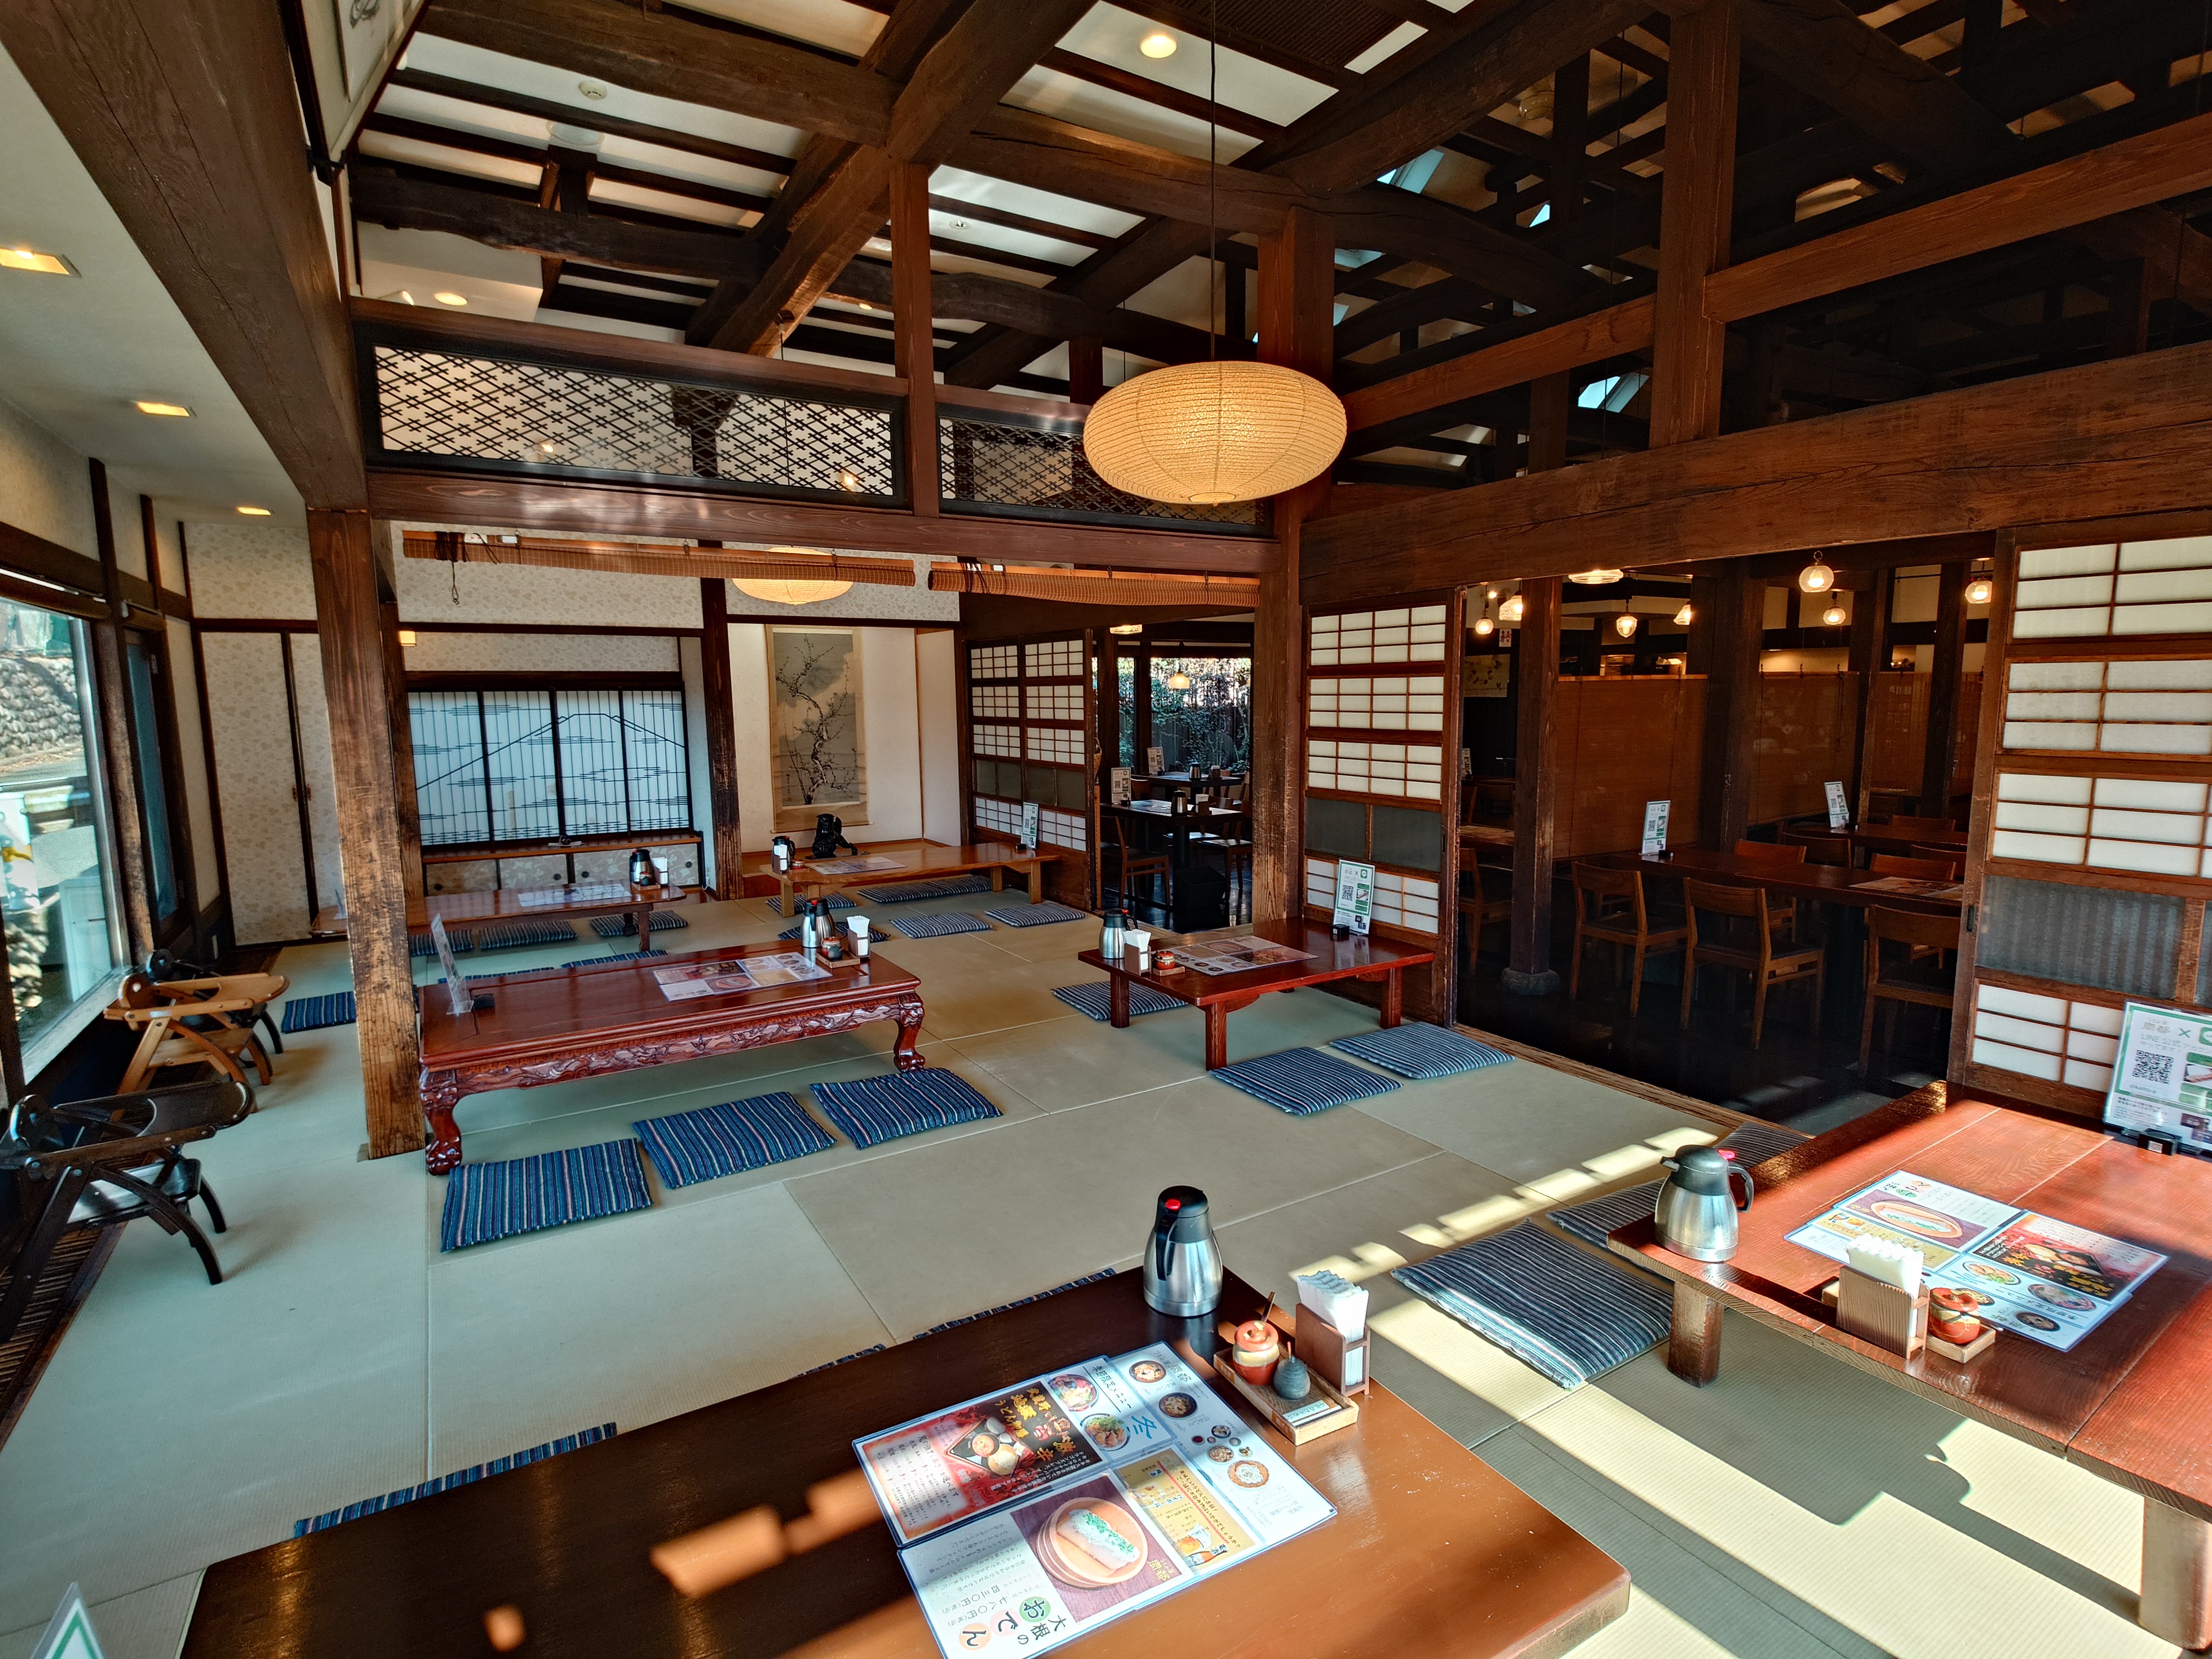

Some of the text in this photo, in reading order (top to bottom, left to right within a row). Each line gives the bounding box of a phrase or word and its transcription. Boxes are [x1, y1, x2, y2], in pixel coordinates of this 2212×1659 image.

[1895, 1180, 1932, 1197] おでん
[1007, 1392, 1040, 1422] 地獄
[1024, 1386, 1053, 1413] 武蔵野
[1090, 1364, 1137, 1410] 季節限定メニュー
[1123, 1411, 1165, 1442] 冬
[993, 1399, 1031, 1439] うどん御膳
[1028, 1437, 1079, 1464] 激辛
[1153, 1493, 1185, 1508] ハイボール
[1001, 1572, 1032, 1588] ハーフサイズ
[1010, 1583, 1040, 1598] フルサイズ
[958, 1595, 1054, 1651] おでん
[1013, 1613, 1071, 1647] 大根の
